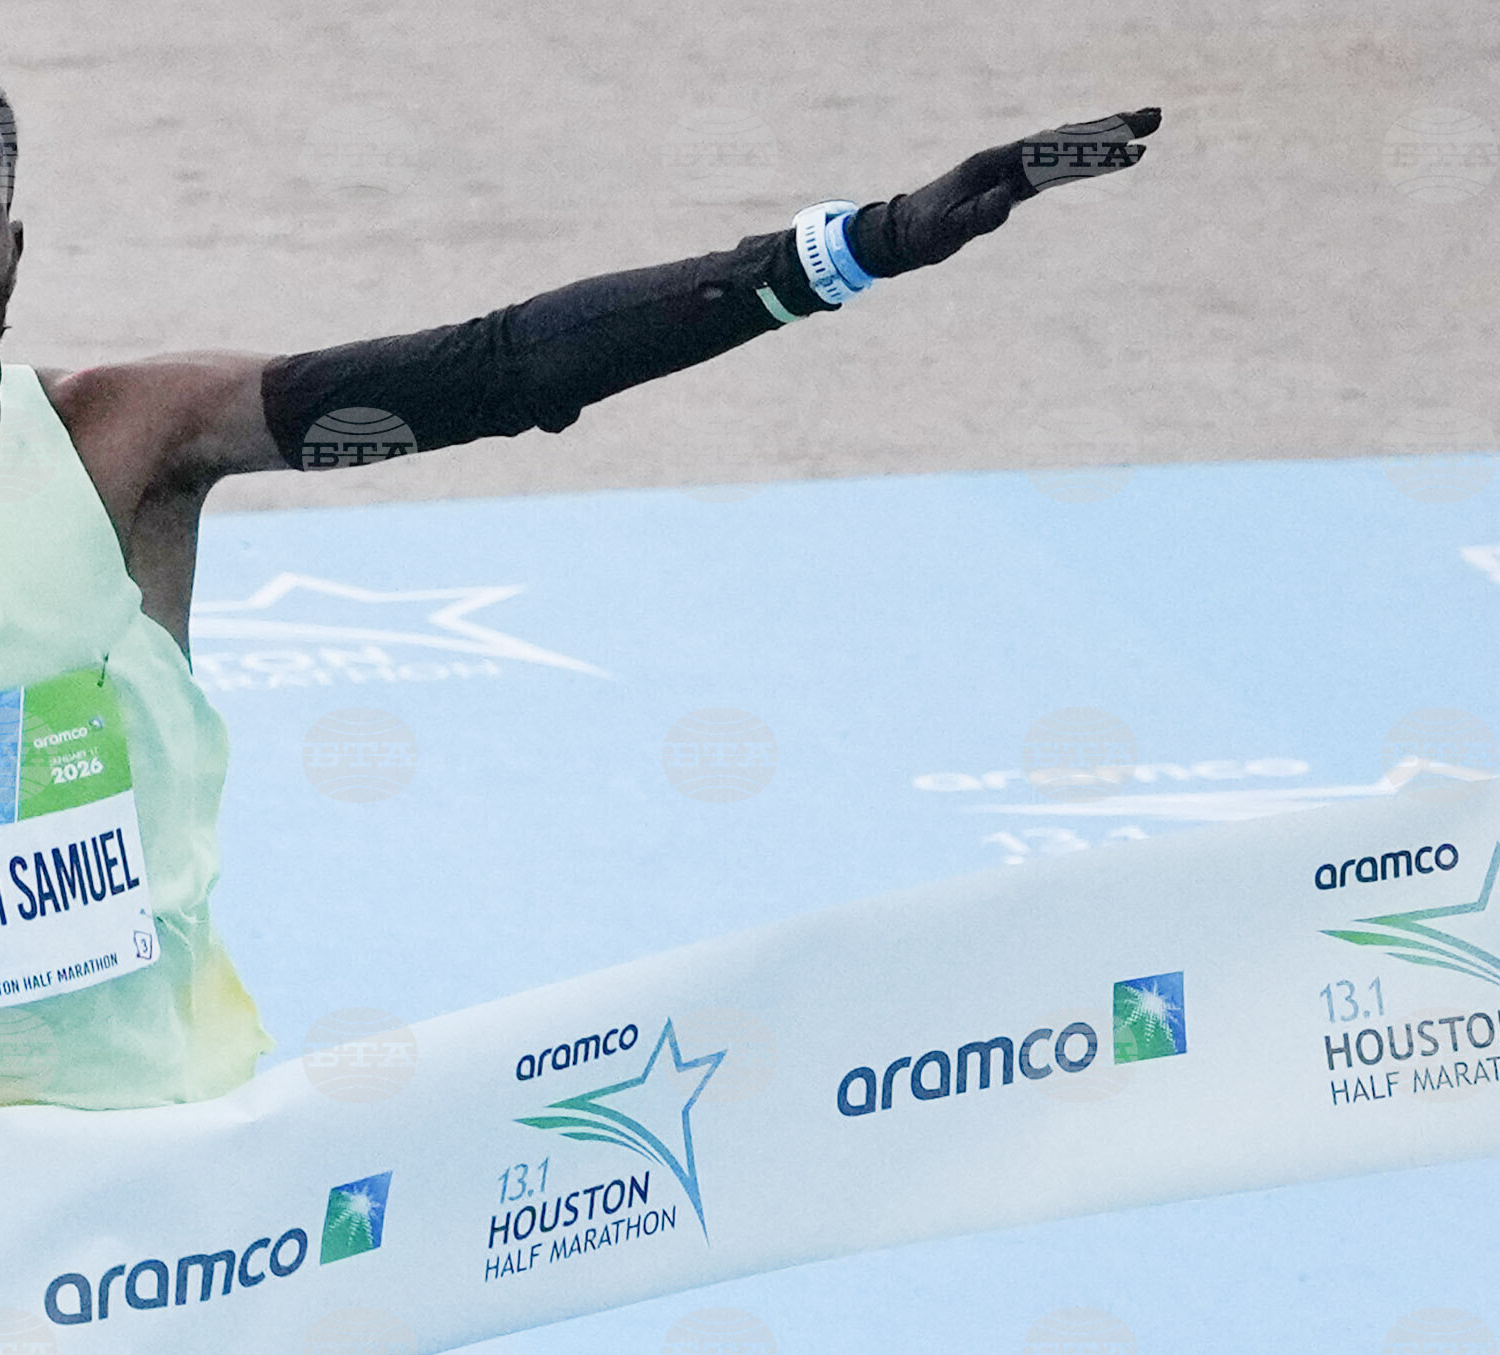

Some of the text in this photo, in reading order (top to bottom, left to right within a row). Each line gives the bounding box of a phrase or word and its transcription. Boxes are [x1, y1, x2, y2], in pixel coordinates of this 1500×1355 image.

[34, 727, 88, 749] aramco
[51, 758, 103, 784] 2026
[9, 828, 140, 921] SAMUEL
[1315, 843, 1459, 890] aramco
[24, 971, 52, 991] HALF
[57, 953, 118, 984] MARATHON
[1319, 976, 1384, 1023] 13.1
[516, 1024, 638, 1081] aramco
[1324, 1010, 1500, 1071] HOUSTO
[837, 1021, 1098, 1117] aramco
[1331, 1071, 1400, 1106] HALF
[498, 1156, 549, 1204] 13.1
[488, 1171, 650, 1249] HOUSTON
[485, 1205, 677, 1282] HALF MARATHON
[44, 1227, 309, 1326] aramco
